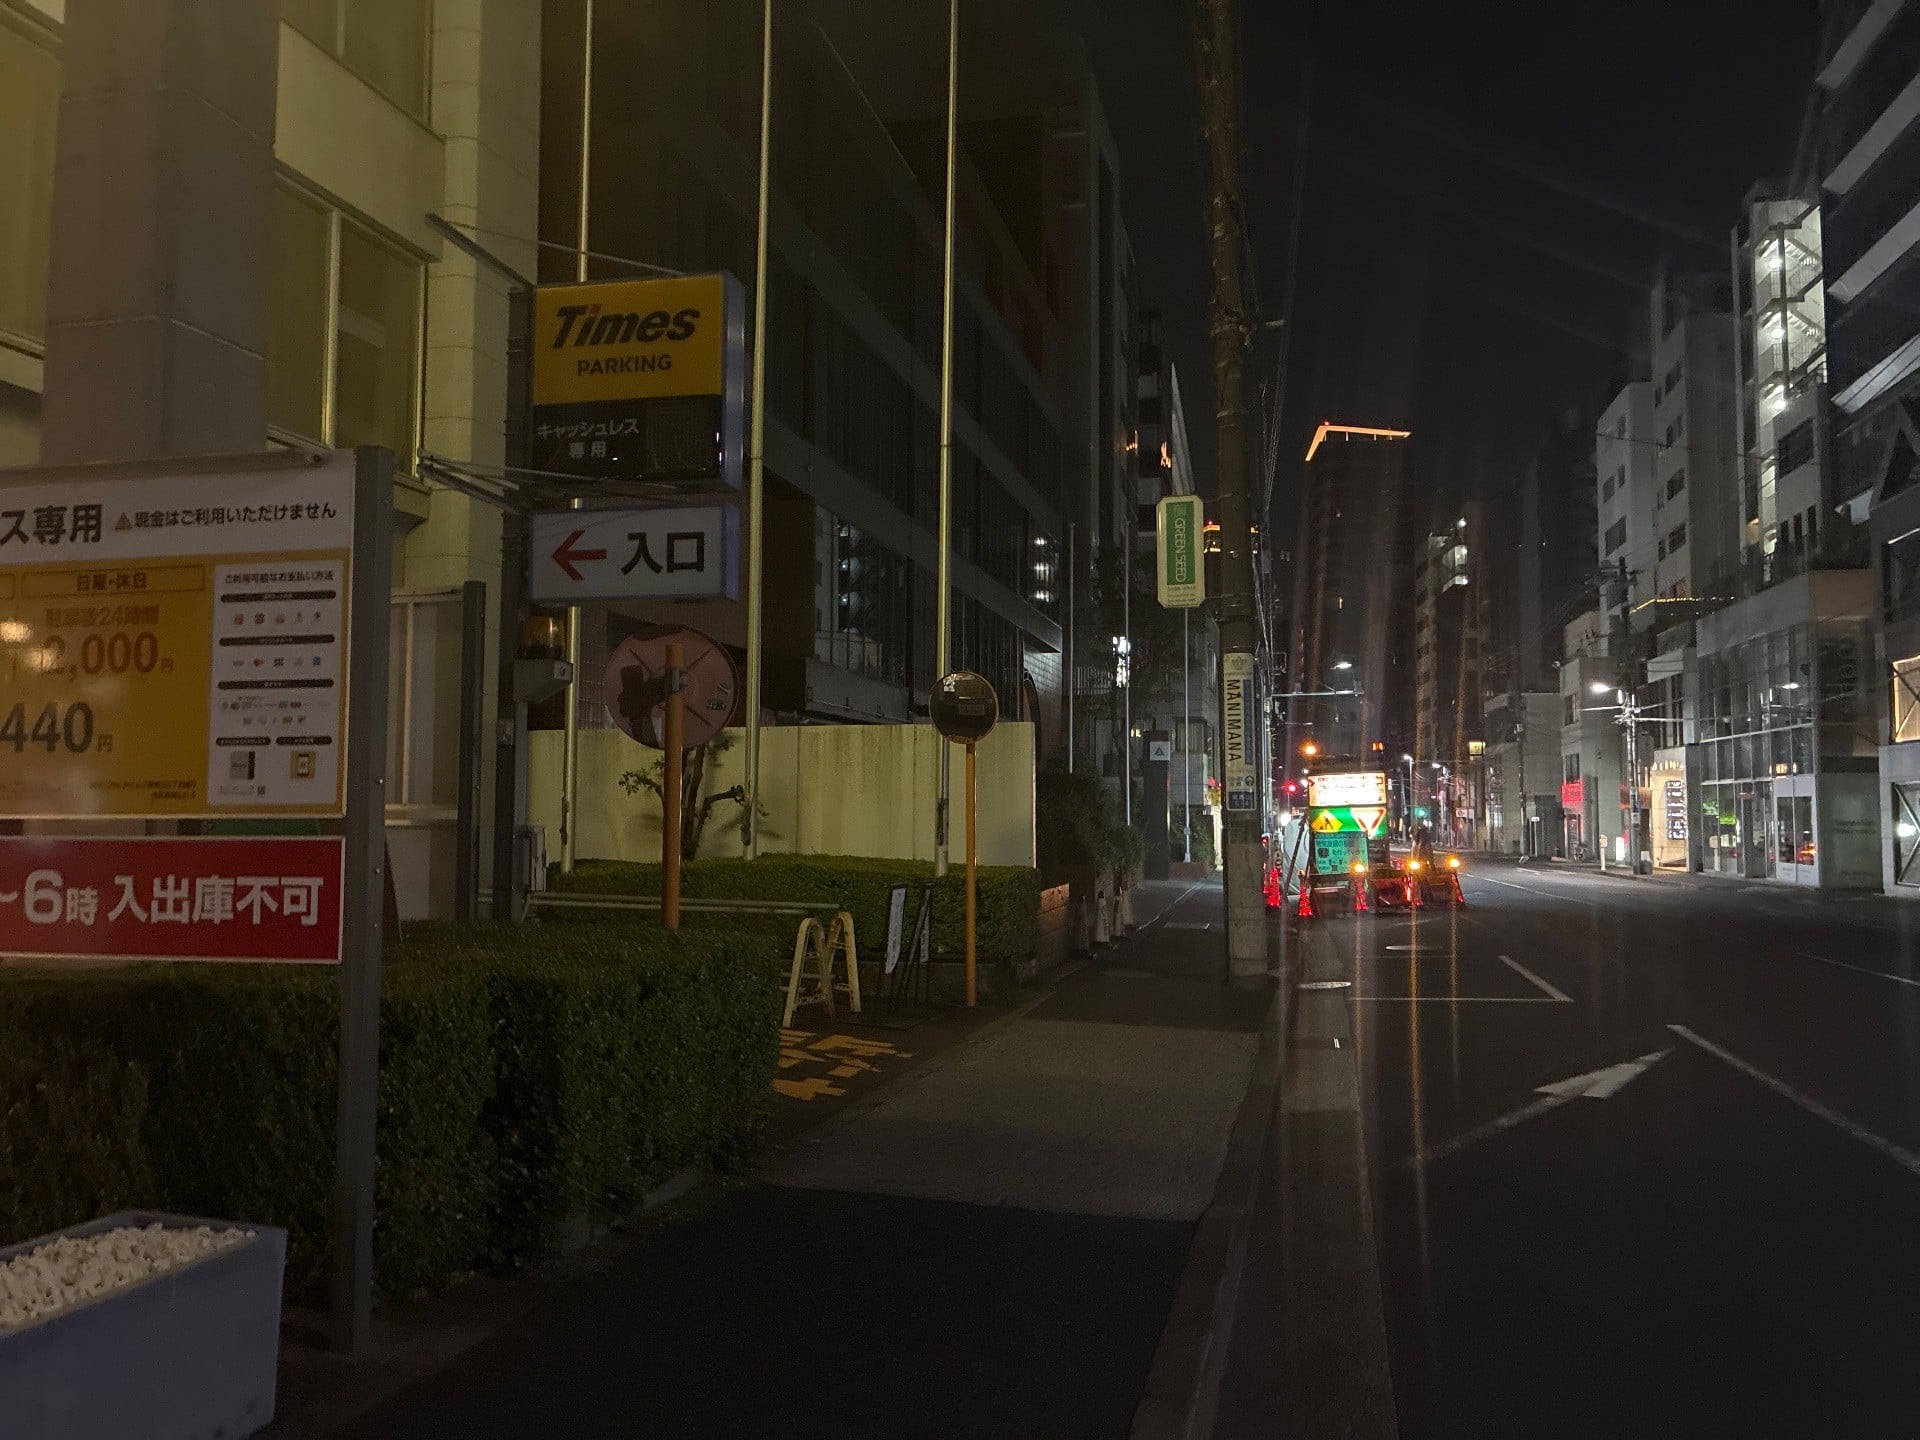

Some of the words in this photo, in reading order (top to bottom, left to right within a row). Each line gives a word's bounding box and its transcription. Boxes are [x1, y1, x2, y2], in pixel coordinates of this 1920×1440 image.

[552, 303, 700, 349] Times
[577, 353, 673, 377] PARKING
[537, 418, 640, 440] キャッシュレス
[568, 440, 608, 459] 専用
[0, 503, 103, 546] ス専用
[134, 502, 337, 529] 現金はご利用いただけません
[1174, 517, 1187, 554] GREEN
[620, 531, 706, 576] 入口
[1174, 554, 1188, 583] SEED
[1226, 679, 1243, 762] MANIMANA
[107, 874, 324, 926] 入出庫不可
